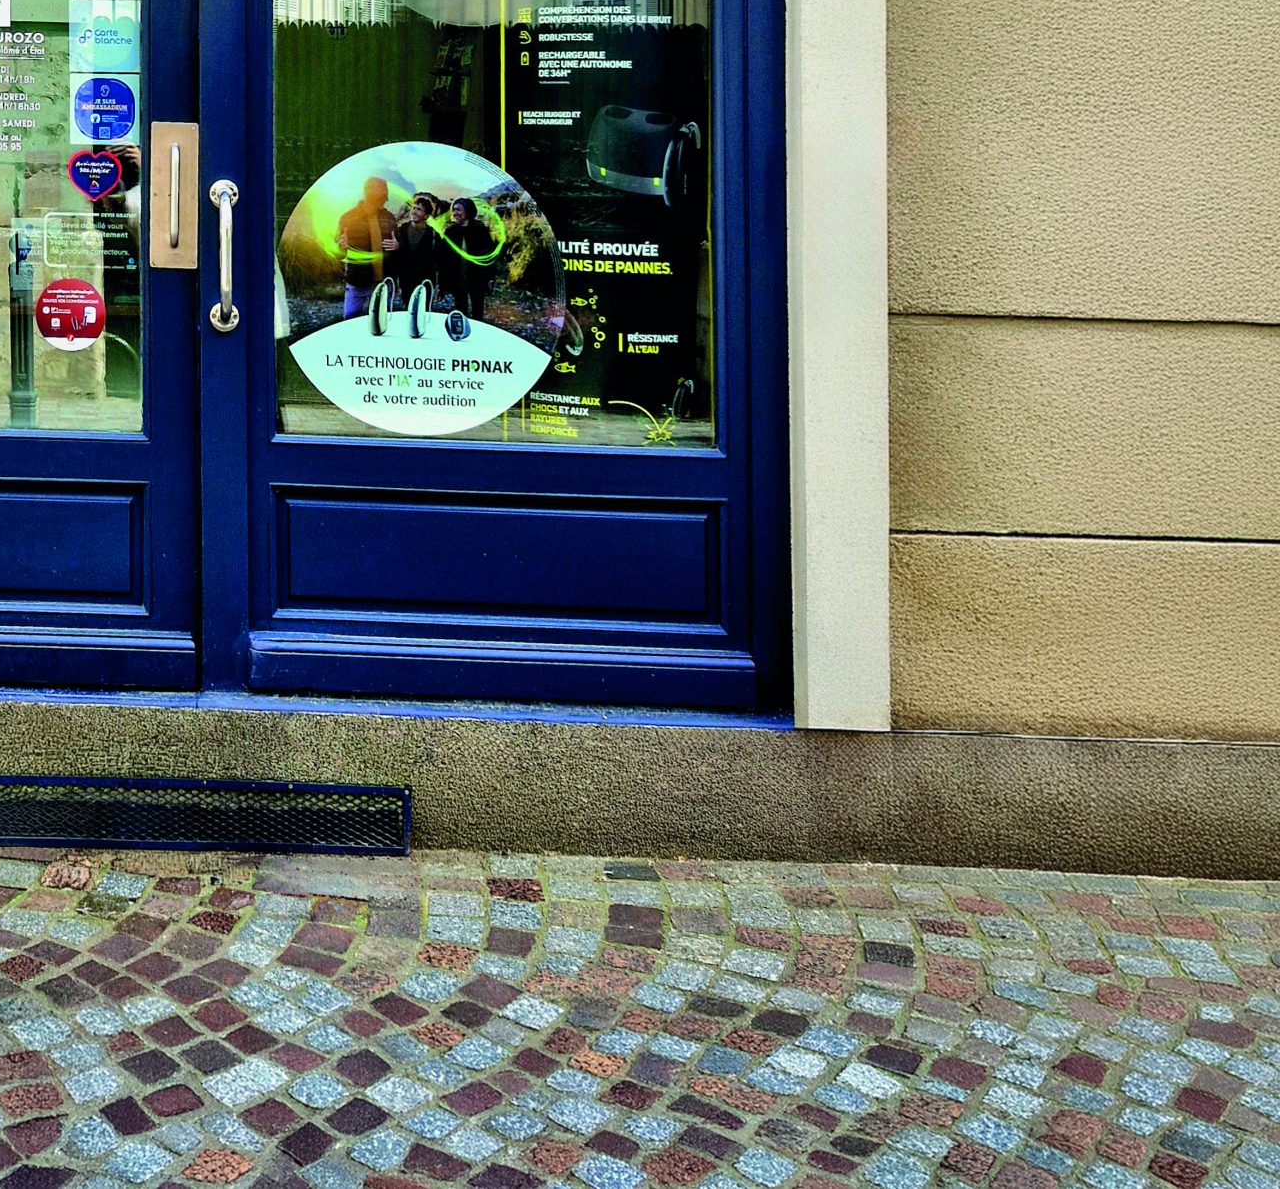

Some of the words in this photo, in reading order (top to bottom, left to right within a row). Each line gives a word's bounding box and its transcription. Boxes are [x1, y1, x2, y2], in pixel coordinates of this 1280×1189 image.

[538, 5, 612, 15] COMPRÉHENSION
[613, 6, 631, 14] DES
[538, 14, 609, 24] CONVERSATIONS
[610, 15, 635, 24] DANS
[636, 15, 647, 24] LE
[648, 15, 672, 24] BRUIT
[94, 29, 119, 37] Carte
[538, 33, 594, 42] ROBUSTESSE
[94, 37, 133, 45] blanche
[21, 44, 45, 55] d'État
[538, 50, 606, 59] RECHARGEABLE
[538, 60, 561, 69] AVEC
[561, 60, 580, 69] UNE
[580, 60, 633, 69] AUTONOMIE
[538, 69, 550, 78] DE
[0, 74, 35, 84] 14h/19h
[2, 119, 36, 128] SAMEDI
[10, 134, 21, 142] au
[10, 143, 22, 151] 95
[593, 240, 659, 257] PROUVÉE
[595, 260, 614, 273] DE
[615, 261, 674, 275] PANNES.
[627, 331, 679, 343] RÉSISTANCE
[627, 343, 635, 353] À
[635, 345, 660, 354] L'EAU
[325, 354, 344, 367] LA
[348, 355, 447, 371] TECHNOLOGIE
[451, 359, 514, 374] PHONAK
[355, 375, 384, 387] avec
[417, 378, 433, 389] au
[438, 378, 485, 391] service
[363, 391, 379, 404] de
[383, 393, 418, 405] votre
[422, 393, 477, 408] audition
[529, 390, 581, 405] RÉSISTANCE
[581, 396, 601, 406] AUX
[529, 402, 559, 413] CHOCS
[559, 405, 570, 414] ET
[570, 407, 590, 416] AUX
[530, 413, 568, 425] RAYURES
[530, 424, 578, 438] RENFORCÉE
